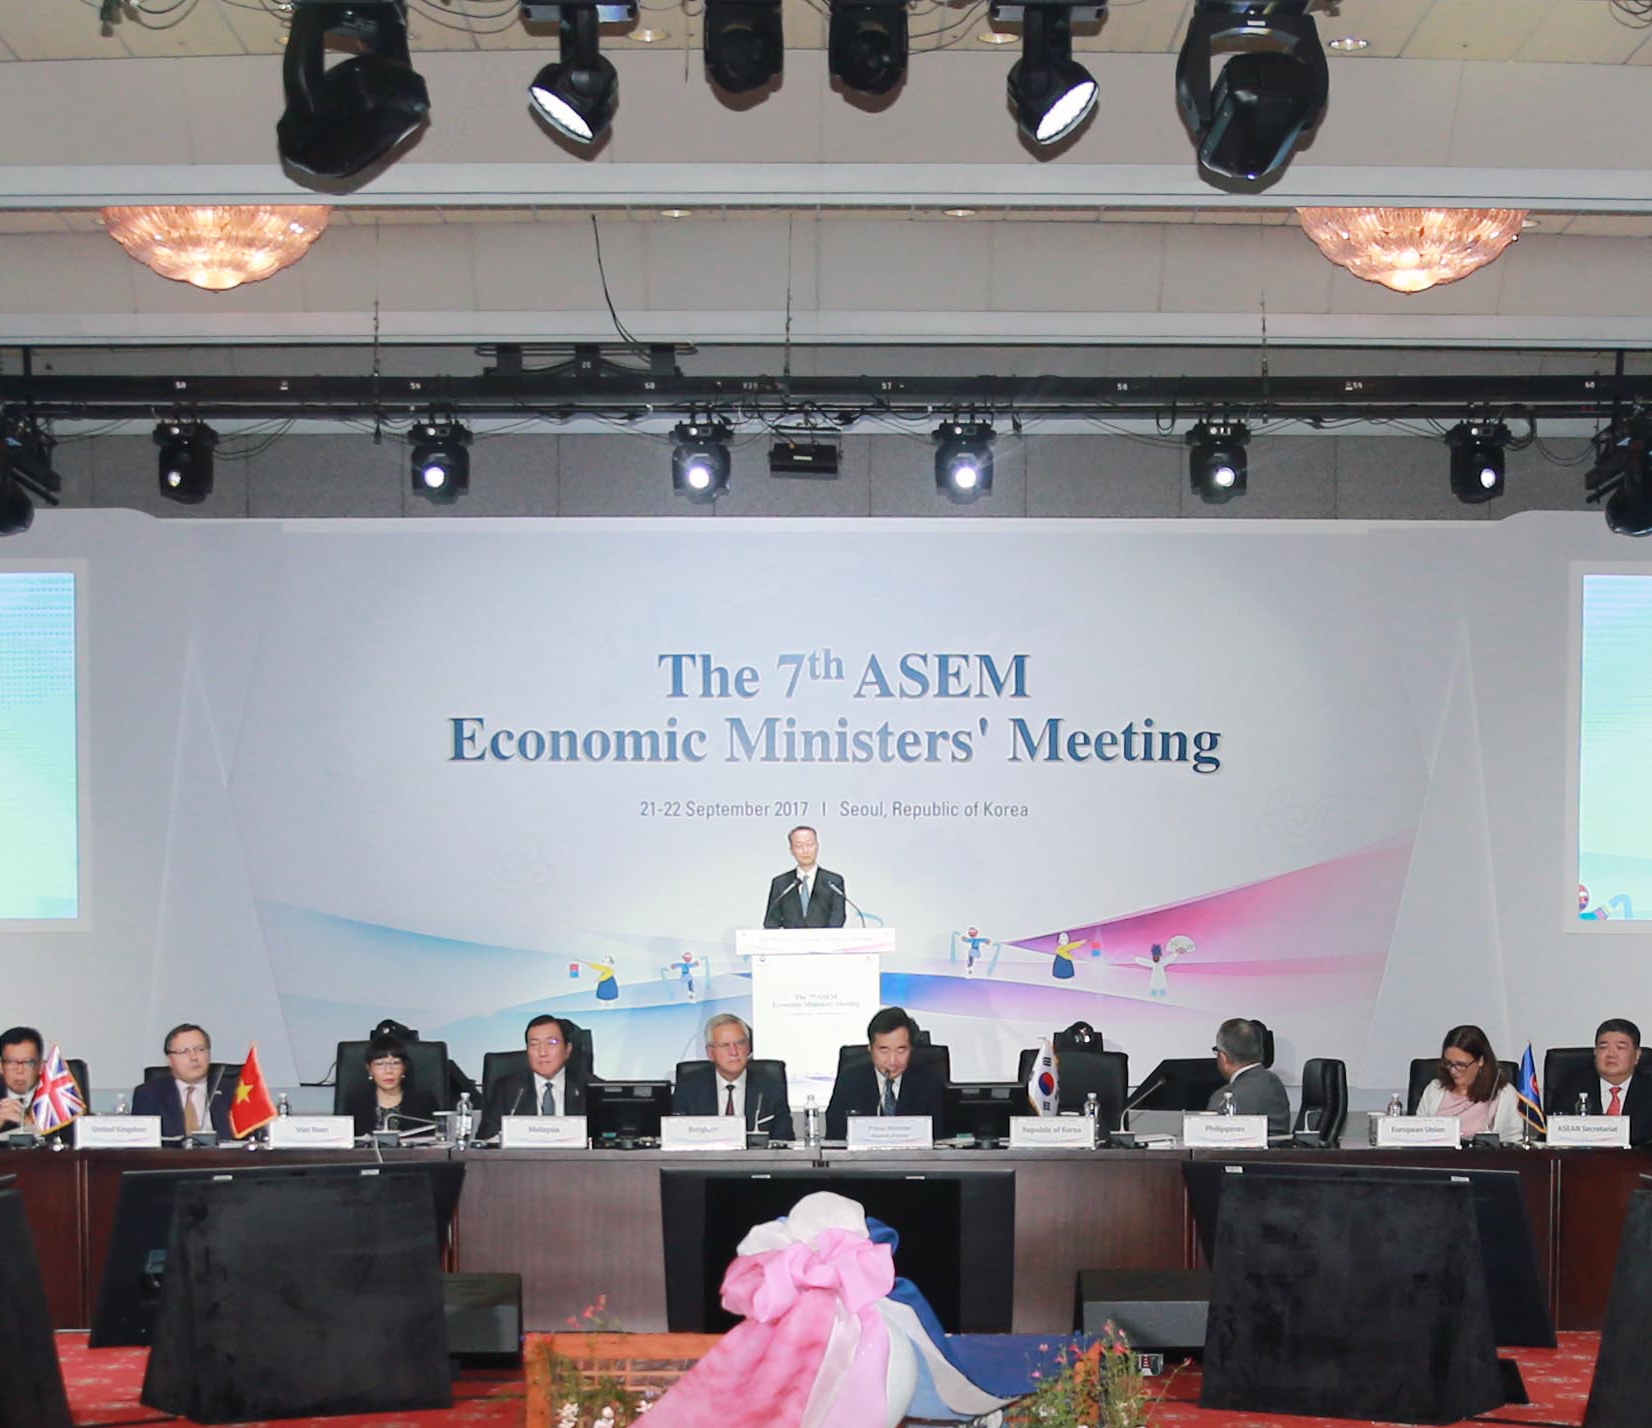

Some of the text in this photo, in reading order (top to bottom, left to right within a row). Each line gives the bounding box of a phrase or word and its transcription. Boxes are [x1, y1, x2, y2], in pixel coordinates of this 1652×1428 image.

[657, 647, 1031, 700] The 7th ASEM
[448, 716, 1222, 775] Economic Ministers' Meeting
[639, 801, 681, 817] 21-22
[685, 801, 770, 820] September
[774, 801, 809, 817] 2017
[839, 800, 888, 819] Seoul,
[892, 800, 960, 819] Republic
[963, 800, 979, 817] of
[983, 801, 1029, 817] Korea
